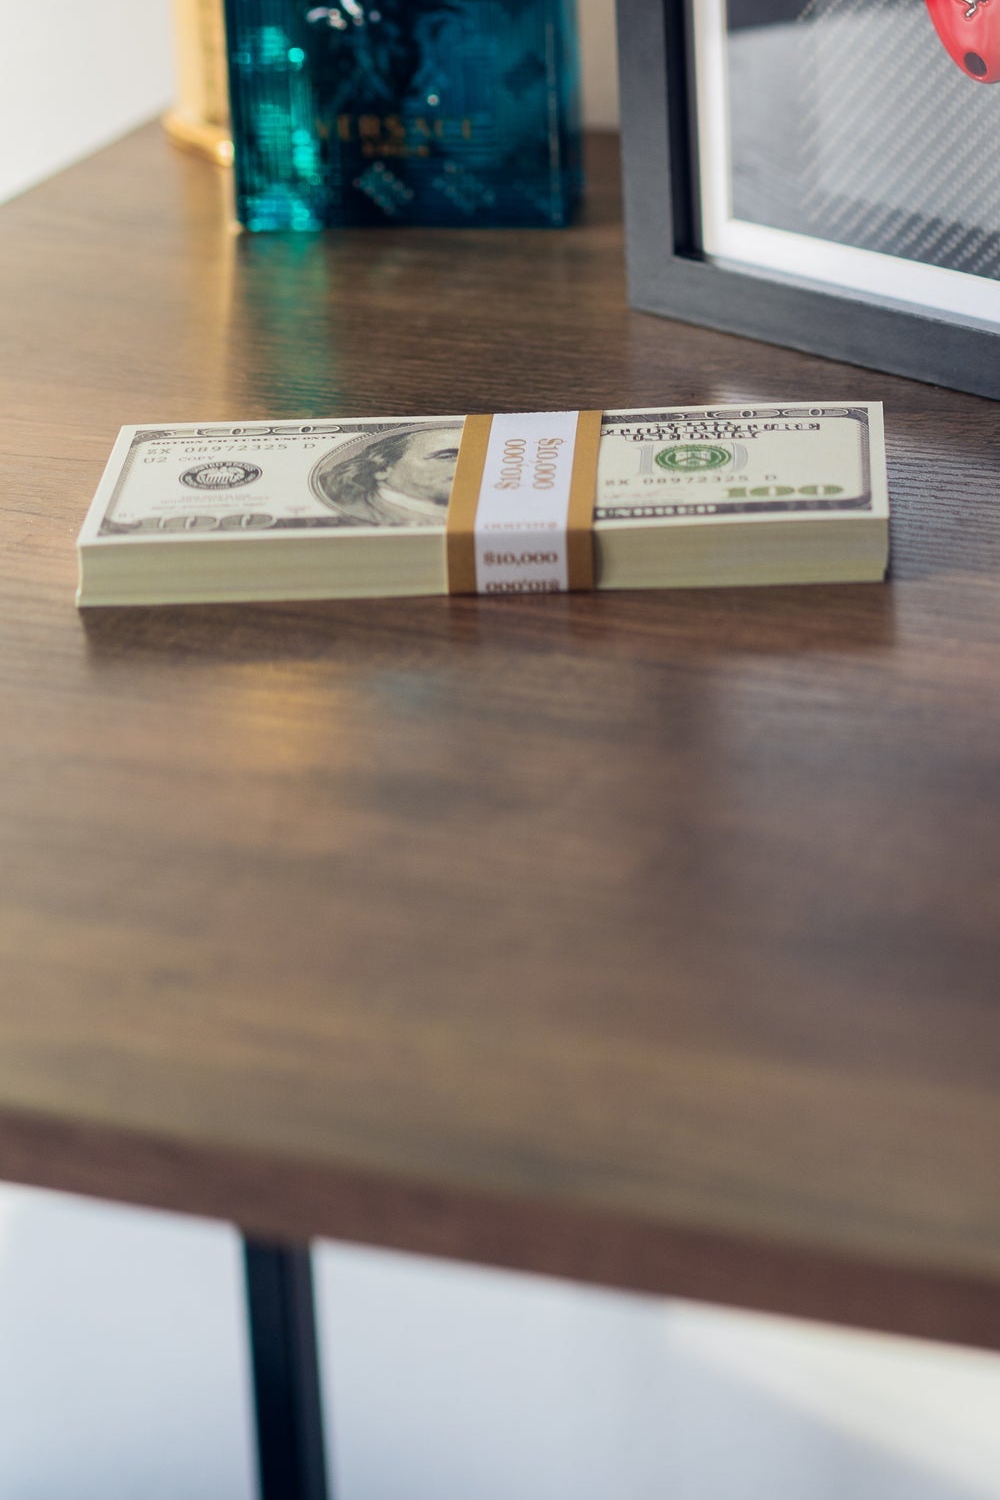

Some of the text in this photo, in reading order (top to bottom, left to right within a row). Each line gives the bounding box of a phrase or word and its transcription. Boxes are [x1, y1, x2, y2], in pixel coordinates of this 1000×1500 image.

[493, 438, 528, 490] $10,000
[531, 437, 566, 490] $10,000
[724, 483, 845, 498] 100
[483, 550, 558, 567] $10,000
